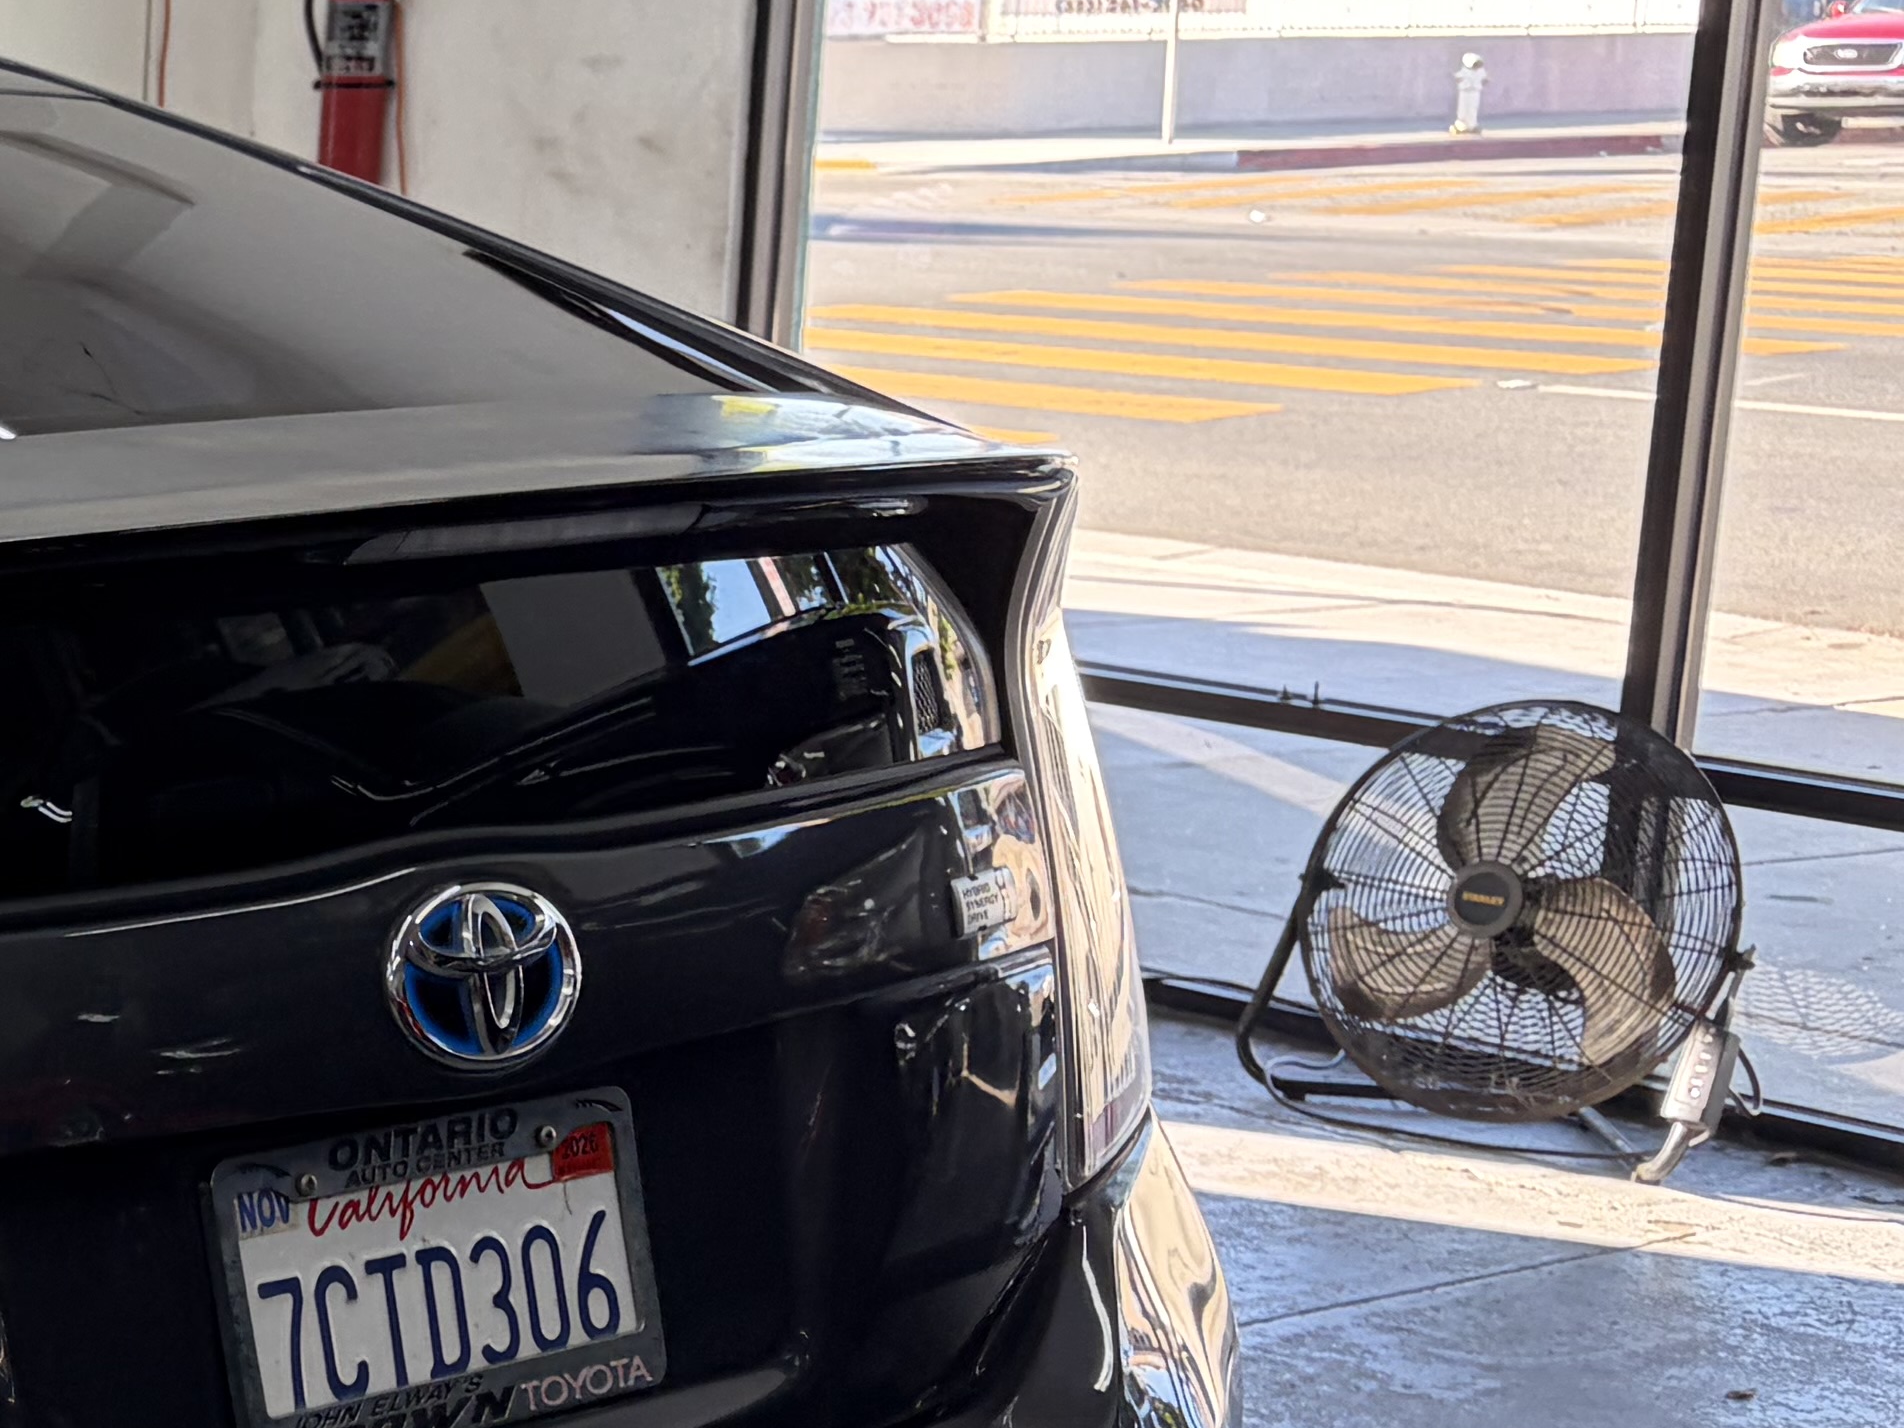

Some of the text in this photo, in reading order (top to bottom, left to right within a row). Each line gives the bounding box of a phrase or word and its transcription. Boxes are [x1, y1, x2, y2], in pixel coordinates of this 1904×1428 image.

[966, 893, 998, 910] SYNERGY
[329, 1107, 519, 1171] ONTARIO
[345, 1142, 506, 1188] AUTO CENTER
[238, 1191, 290, 1233] NOV
[308, 1157, 554, 1240] California
[258, 1210, 621, 1411] 7CTD306
[372, 1373, 483, 1417] ELWAY'S
[520, 1355, 654, 1412] TOYOTA
